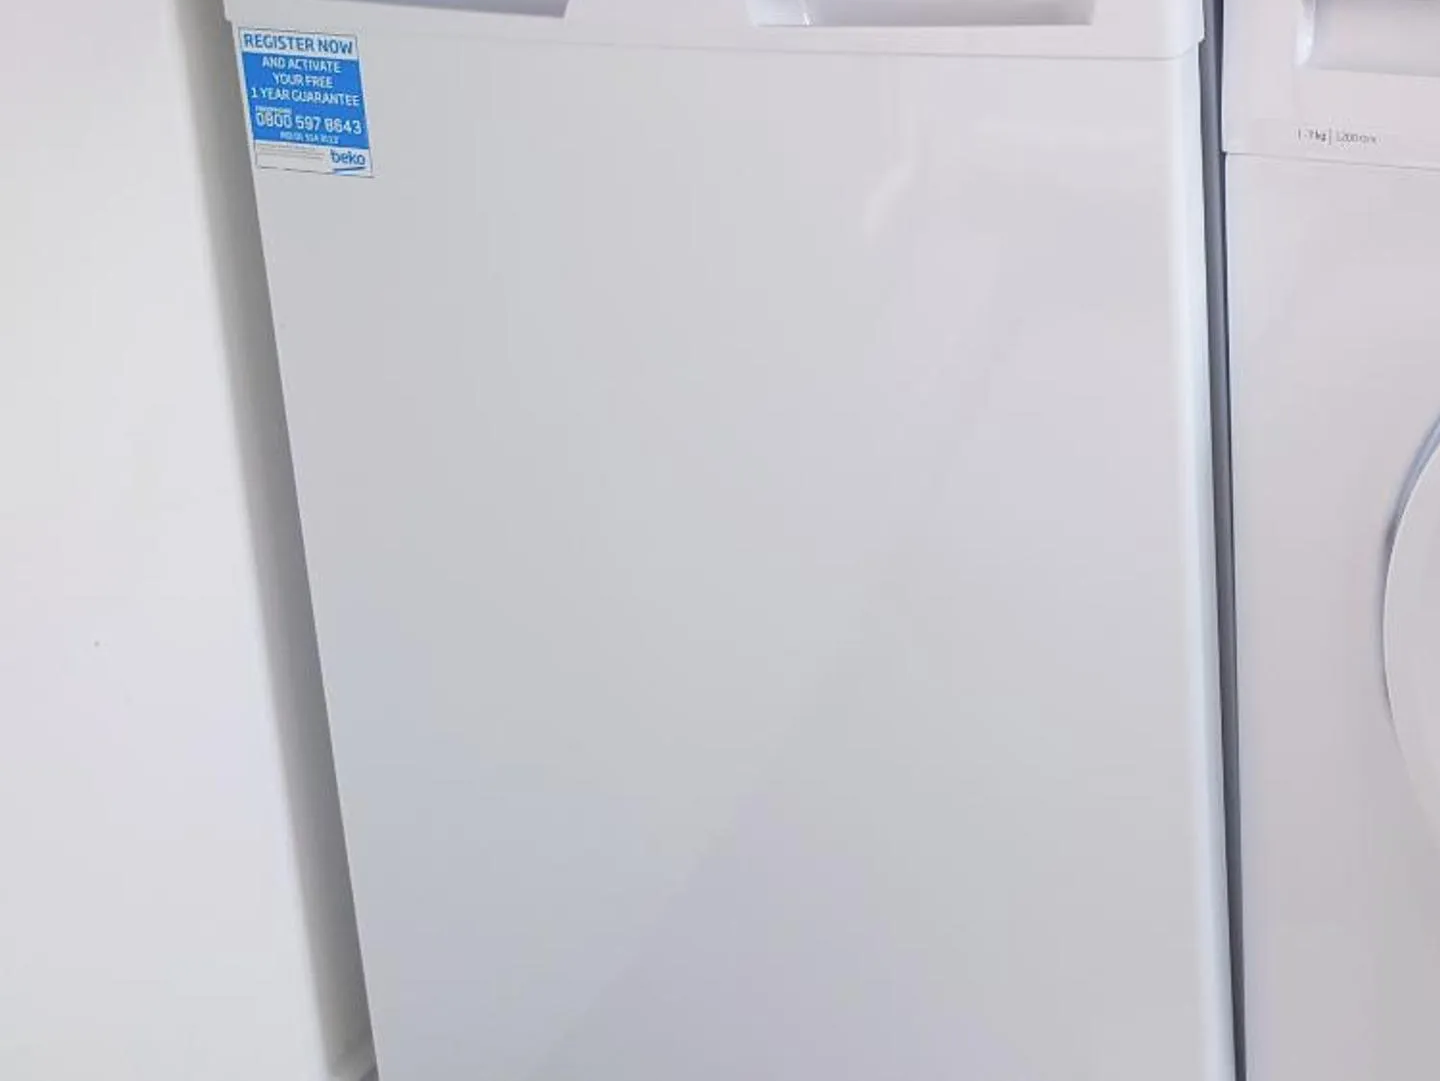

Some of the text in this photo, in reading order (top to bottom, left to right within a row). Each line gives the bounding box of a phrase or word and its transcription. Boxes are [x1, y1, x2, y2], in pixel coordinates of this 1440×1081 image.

[243, 33, 354, 55] REGISTER NOW
[262, 56, 342, 74] AND ACTIVATE
[272, 72, 334, 89] YOUR FREE
[251, 87, 361, 106] 1 YEAR GUARANTEE
[255, 112, 363, 135] 0800 597 8643
[329, 149, 367, 167] beko
